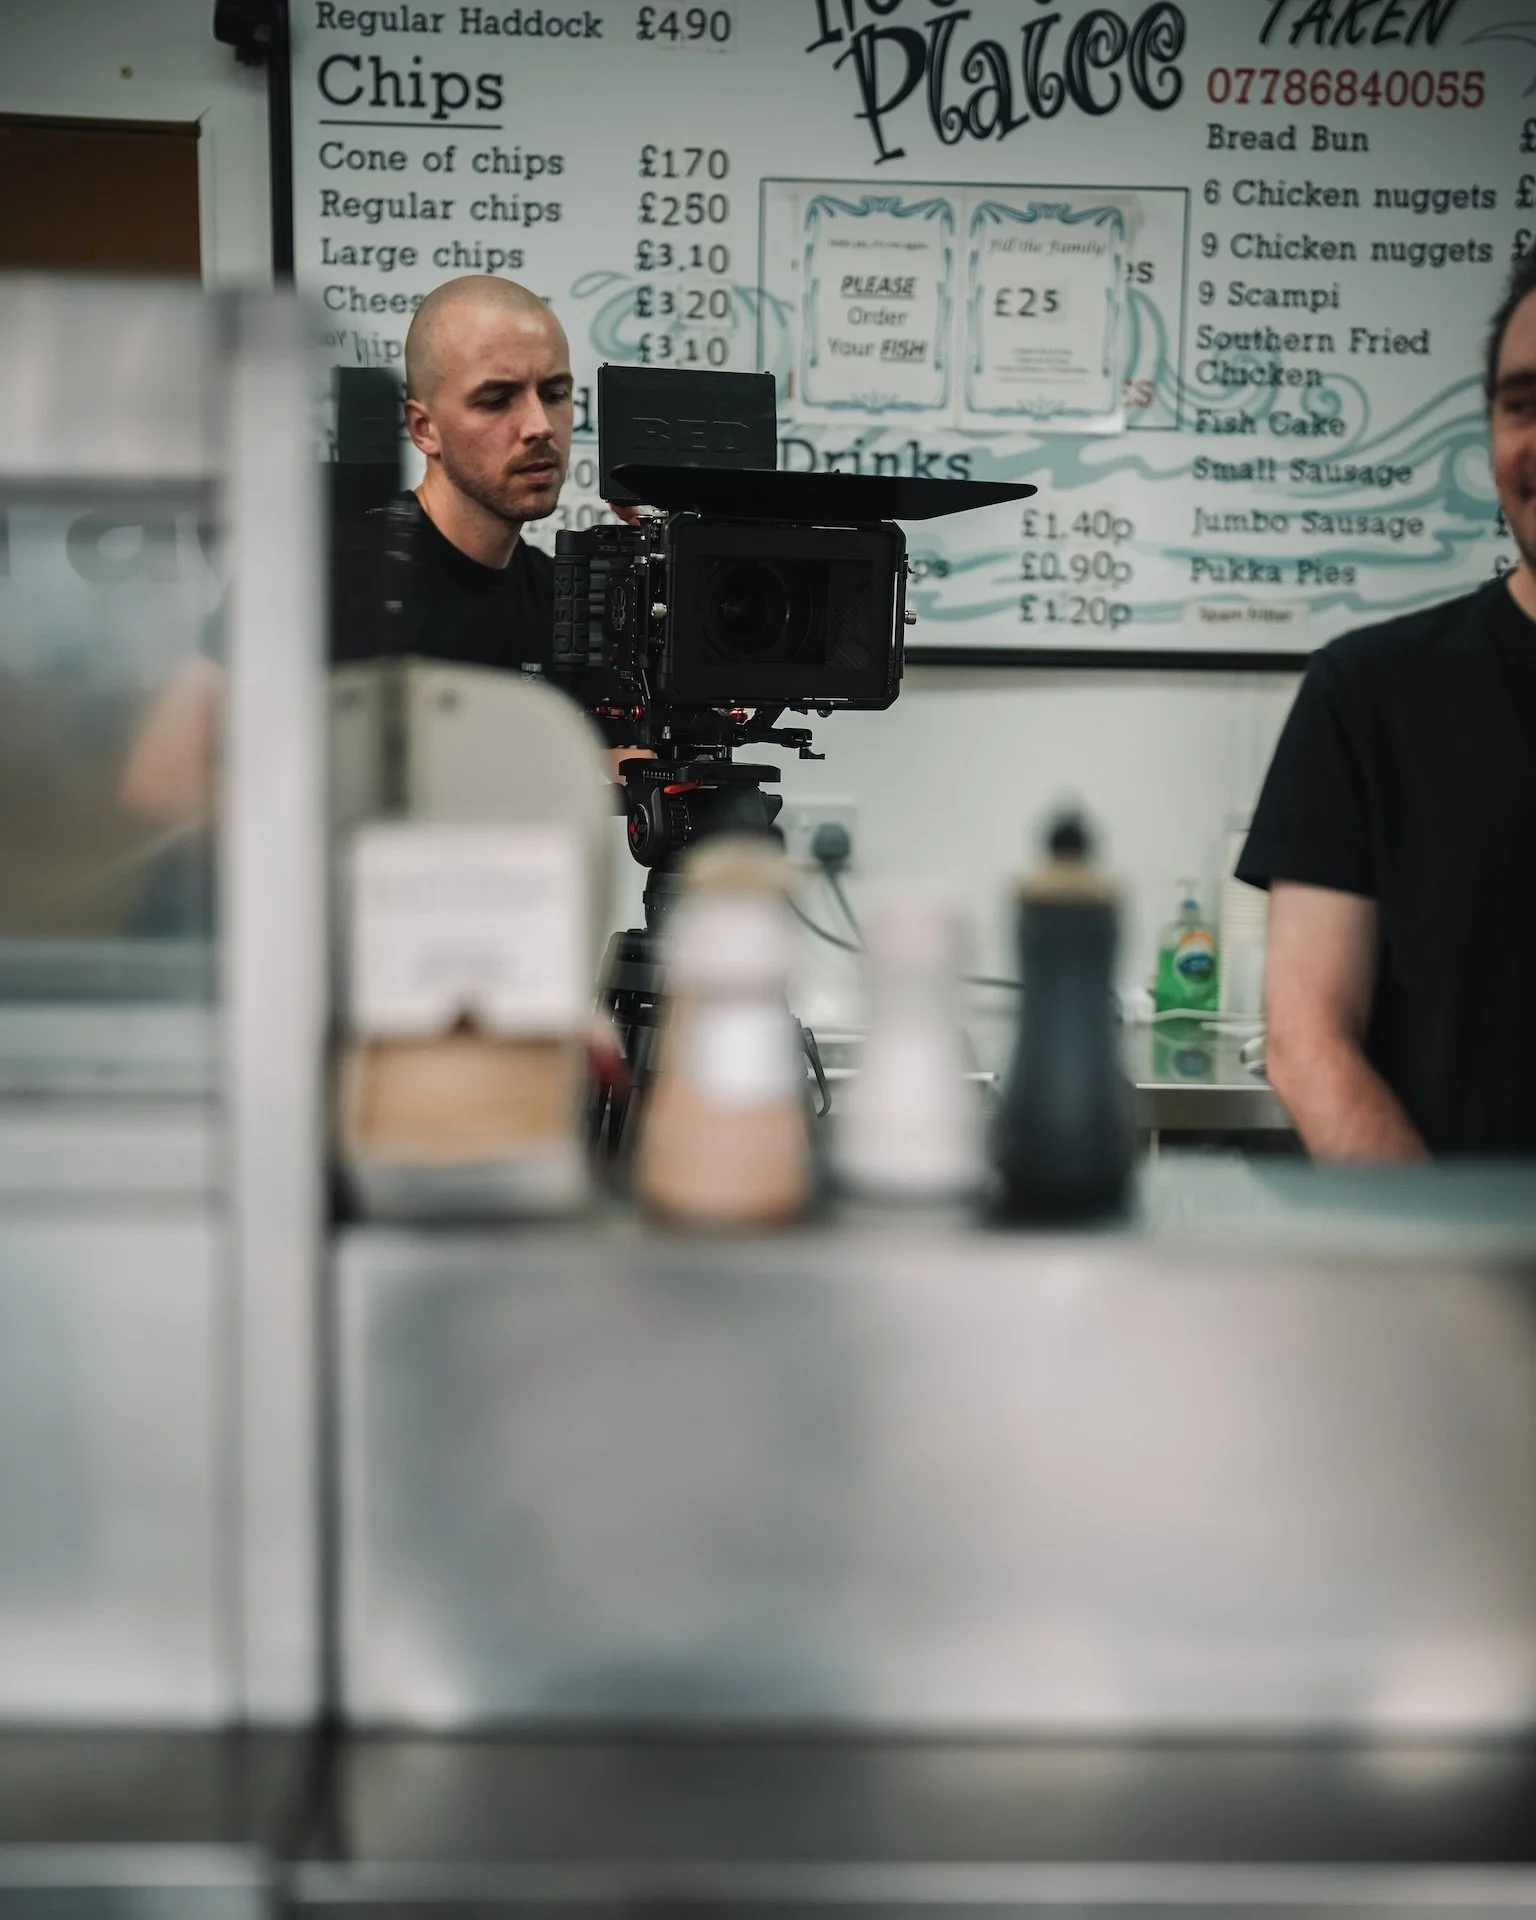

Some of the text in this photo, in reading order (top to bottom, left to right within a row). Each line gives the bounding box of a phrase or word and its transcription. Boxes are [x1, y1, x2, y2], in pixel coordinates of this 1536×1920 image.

[315, 1, 445, 38] Regular
[458, 7, 604, 39] Haddock
[317, 53, 504, 120] Chips
[833, 2, 1187, 165] Plaice
[1206, 66, 1485, 108] 07786840055
[1206, 122, 1370, 152] Bread Bun
[318, 141, 408, 172] Cone
[422, 145, 458, 173] of
[471, 146, 565, 180] chips
[319, 189, 454, 224] Regular
[469, 193, 562, 228] chips
[1203, 178, 1221, 206] 6
[1232, 178, 1360, 208] Chicken
[1372, 184, 1497, 215] nuggets
[320, 236, 731, 275] Large chips £3.10
[1201, 231, 1219, 259] 9
[1229, 232, 1357, 262] Chicken
[1369, 238, 1494, 268] nuggets
[841, 276, 916, 296] PLEASE
[995, 287, 1059, 317] £25
[1198, 279, 1340, 314] 9 Scampi
[847, 306, 908, 326] Order
[828, 338, 928, 358] Your FISH
[1195, 323, 1430, 355] Southern Fried
[1194, 359, 1323, 388] Chicken
[1193, 408, 1347, 437] Fish Cake
[784, 438, 973, 480] Drinks
[1192, 456, 1414, 490] Small Sausage
[1021, 508, 1135, 546] £1.40p
[1191, 507, 1425, 540] Jumbo Sausage
[1189, 556, 1358, 586] Pukka Pies
[1018, 593, 1133, 630] £1.20p
